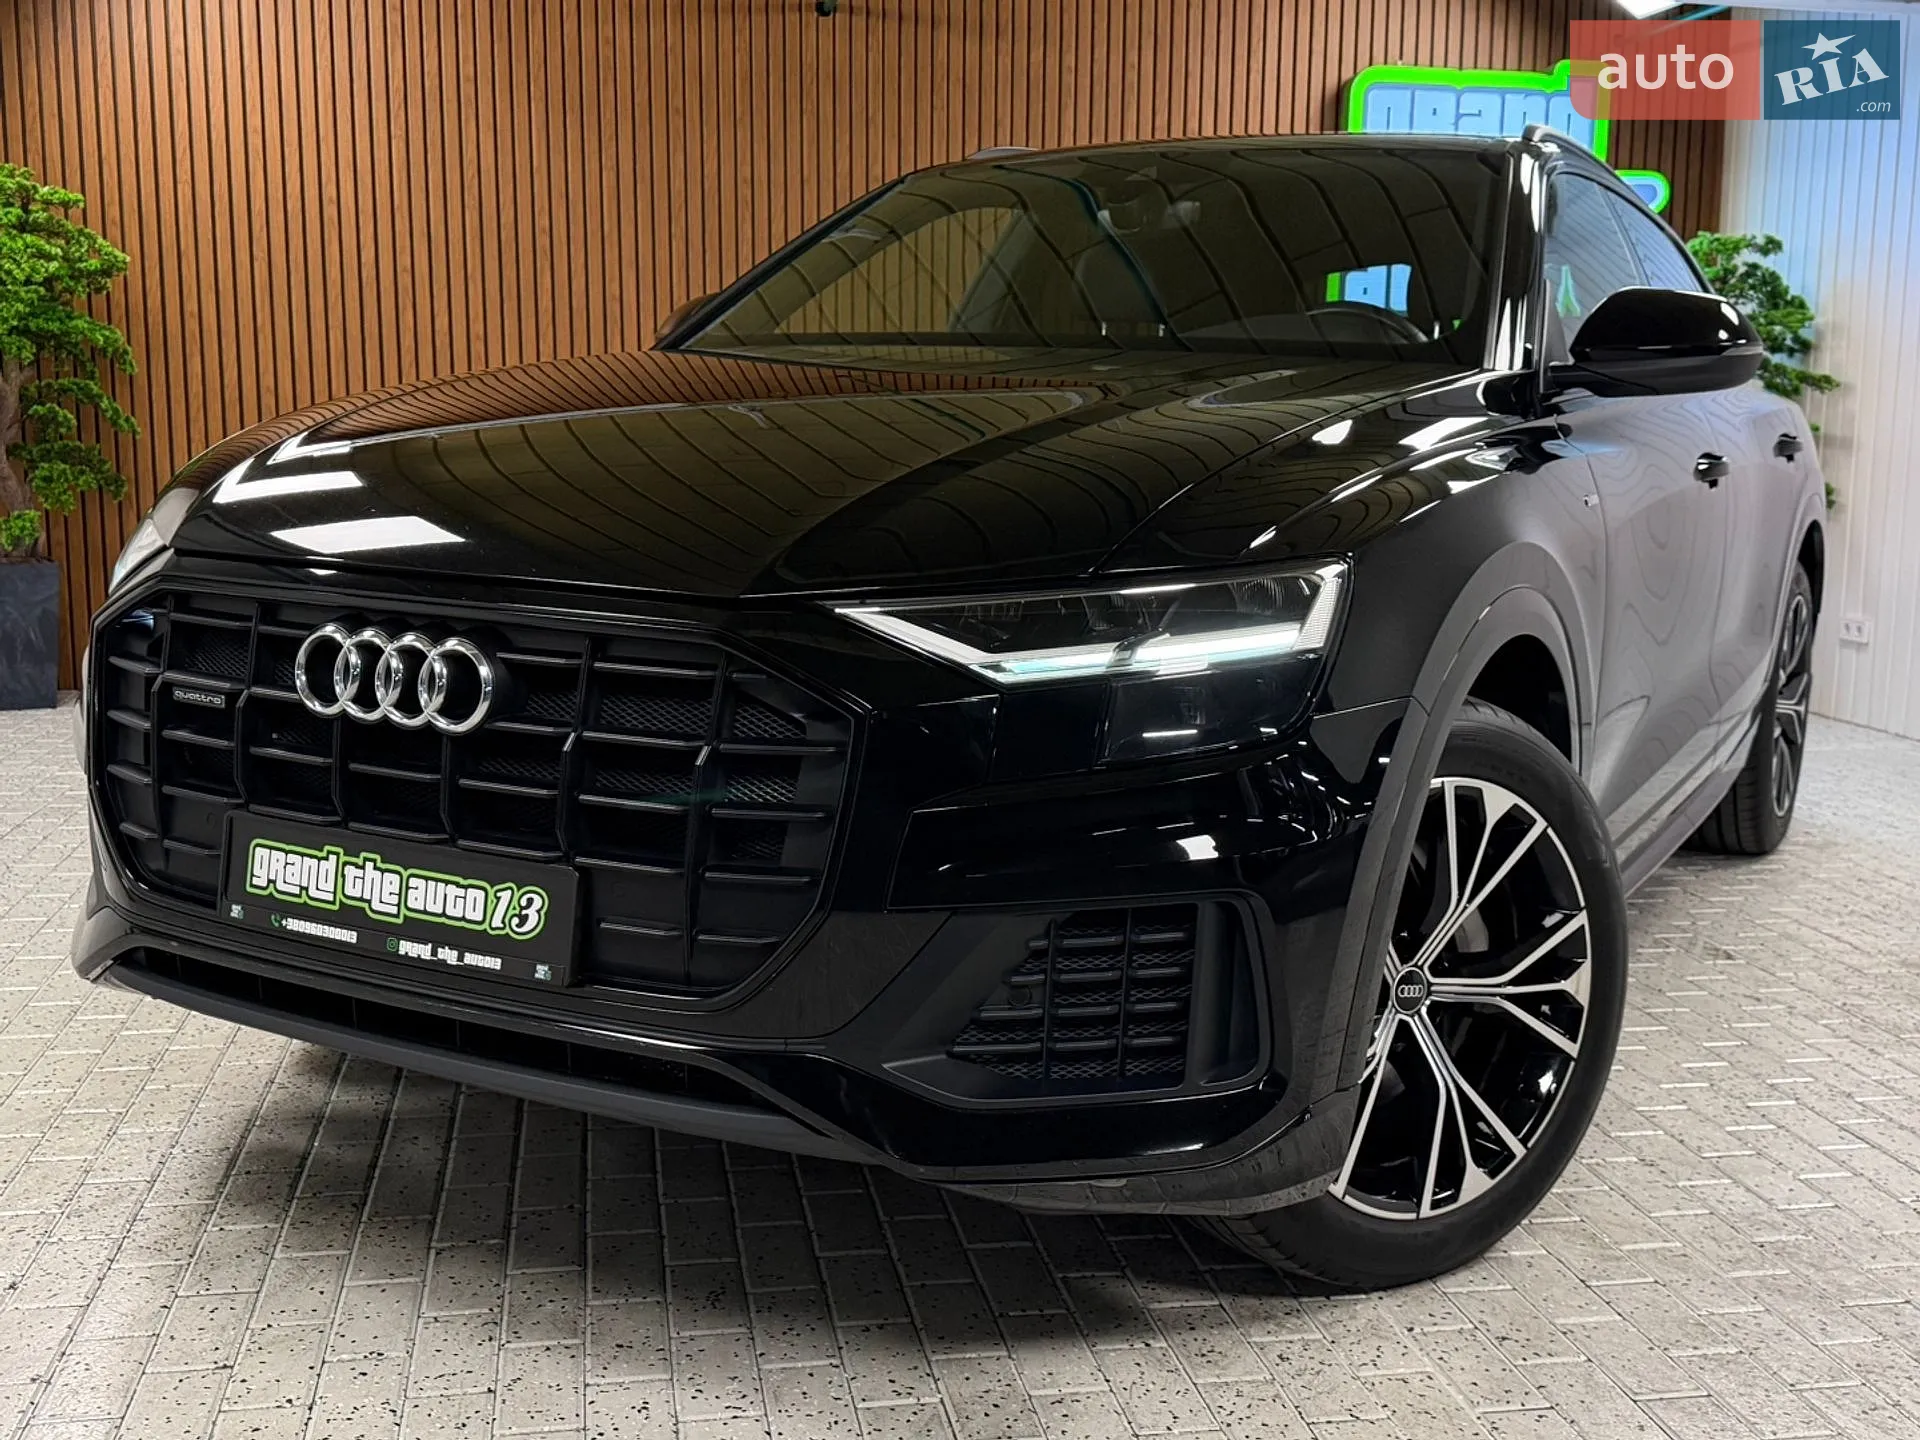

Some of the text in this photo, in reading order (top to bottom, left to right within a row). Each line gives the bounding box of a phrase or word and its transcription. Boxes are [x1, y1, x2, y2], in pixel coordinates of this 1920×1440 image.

[174, 690, 221, 704] quattro
[252, 846, 337, 901] grand
[344, 861, 400, 915] the
